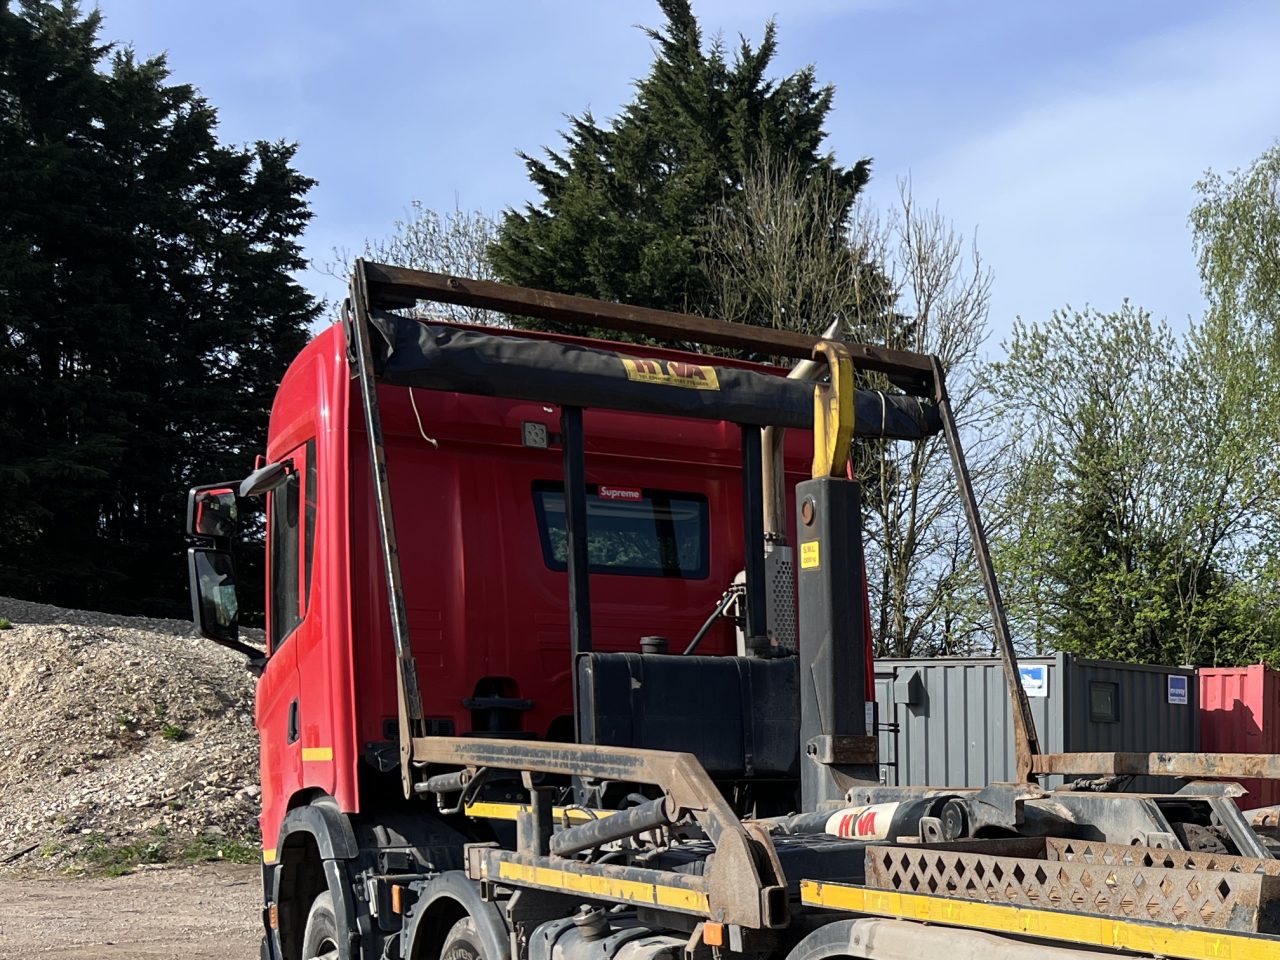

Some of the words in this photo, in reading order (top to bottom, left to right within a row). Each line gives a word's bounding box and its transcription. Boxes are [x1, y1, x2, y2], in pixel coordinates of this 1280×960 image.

[632, 359, 707, 380] HYVA
[601, 486, 640, 499] Supreme
[838, 807, 877, 838] HYVA
